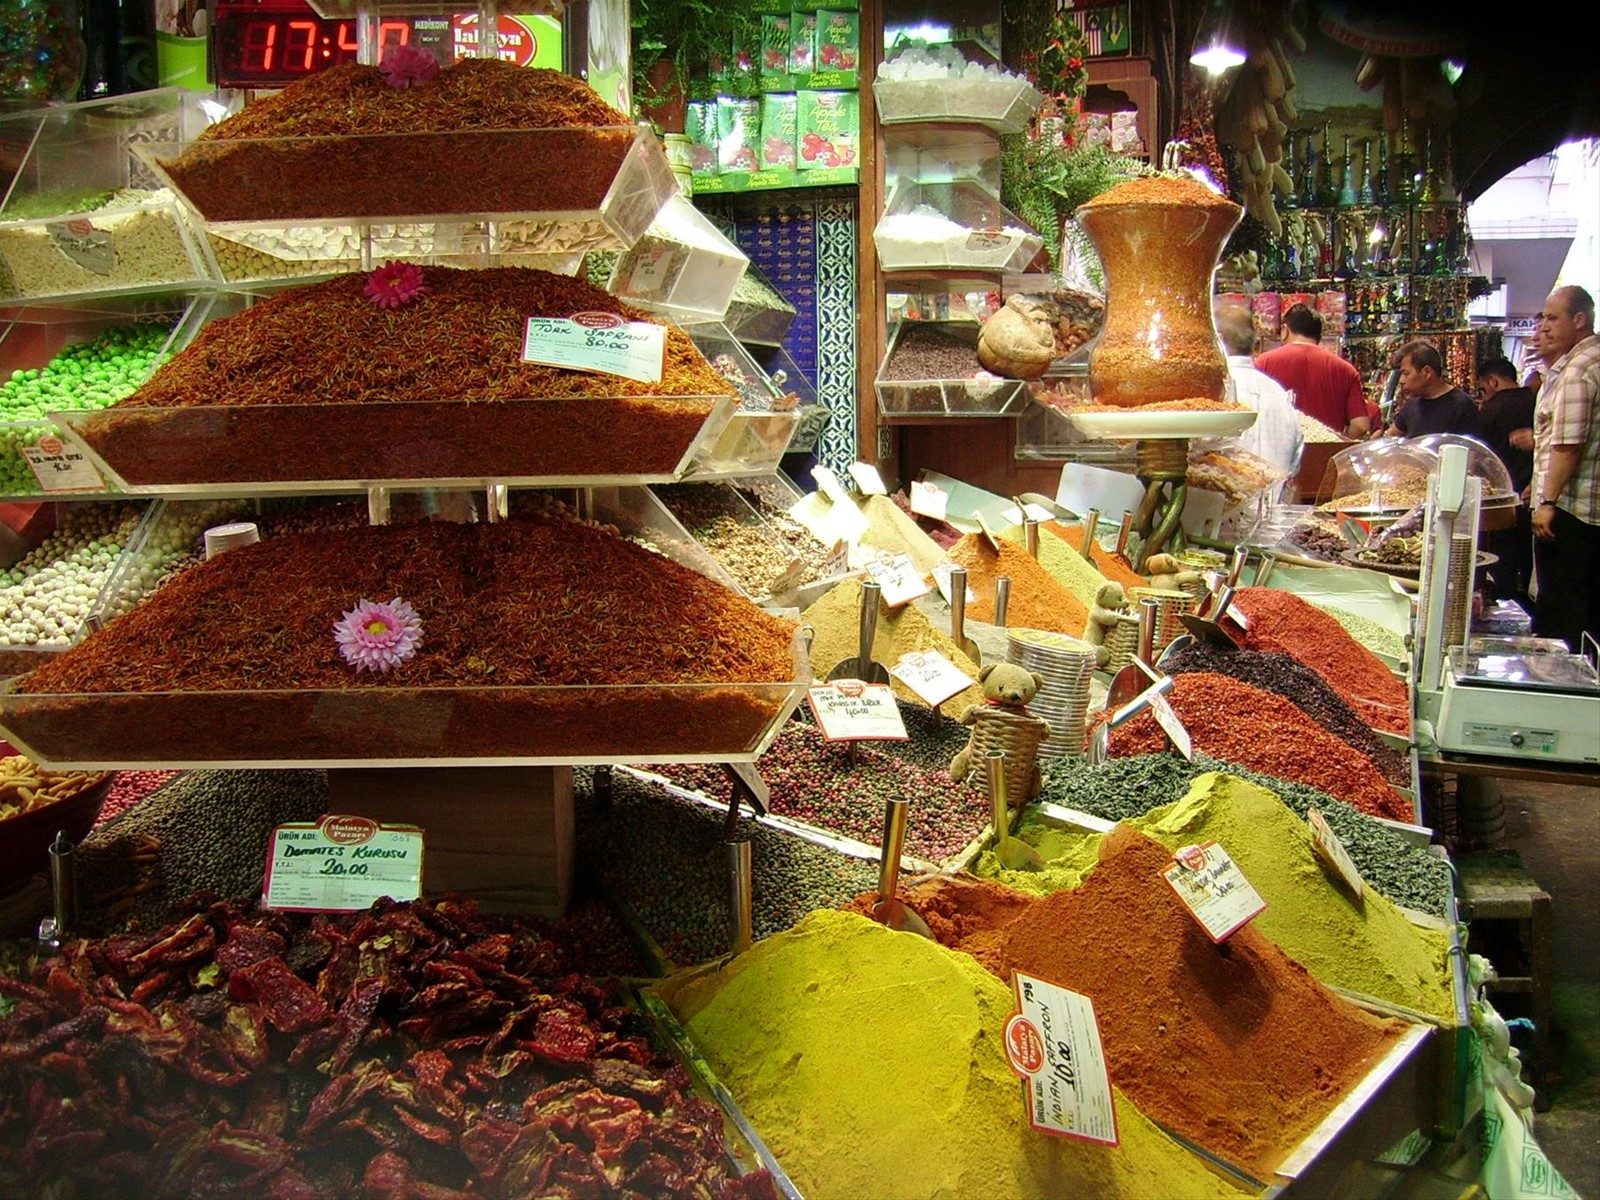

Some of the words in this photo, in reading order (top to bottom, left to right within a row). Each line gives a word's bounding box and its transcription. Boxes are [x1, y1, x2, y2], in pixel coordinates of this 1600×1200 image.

[825, 24, 853, 34] Apple
[830, 34, 847, 44] Tea
[808, 106, 847, 119] Apple
[816, 119, 841, 132] Tea
[584, 337, 630, 350] 80.00
[330, 823, 370, 833] Malatya
[278, 830, 300, 841] ÜRÜN
[332, 831, 367, 839] Pazarı
[351, 845, 408, 859] KURUSU
[319, 857, 369, 876] 20.00
[1036, 1000, 1057, 1068] SAFFRON
[1018, 1023, 1031, 1067] Malatya
[1027, 1029, 1038, 1064] Pazarı
[1054, 1040, 1076, 1092] 10.00
[1035, 1100, 1046, 1124] ÜRÜN
